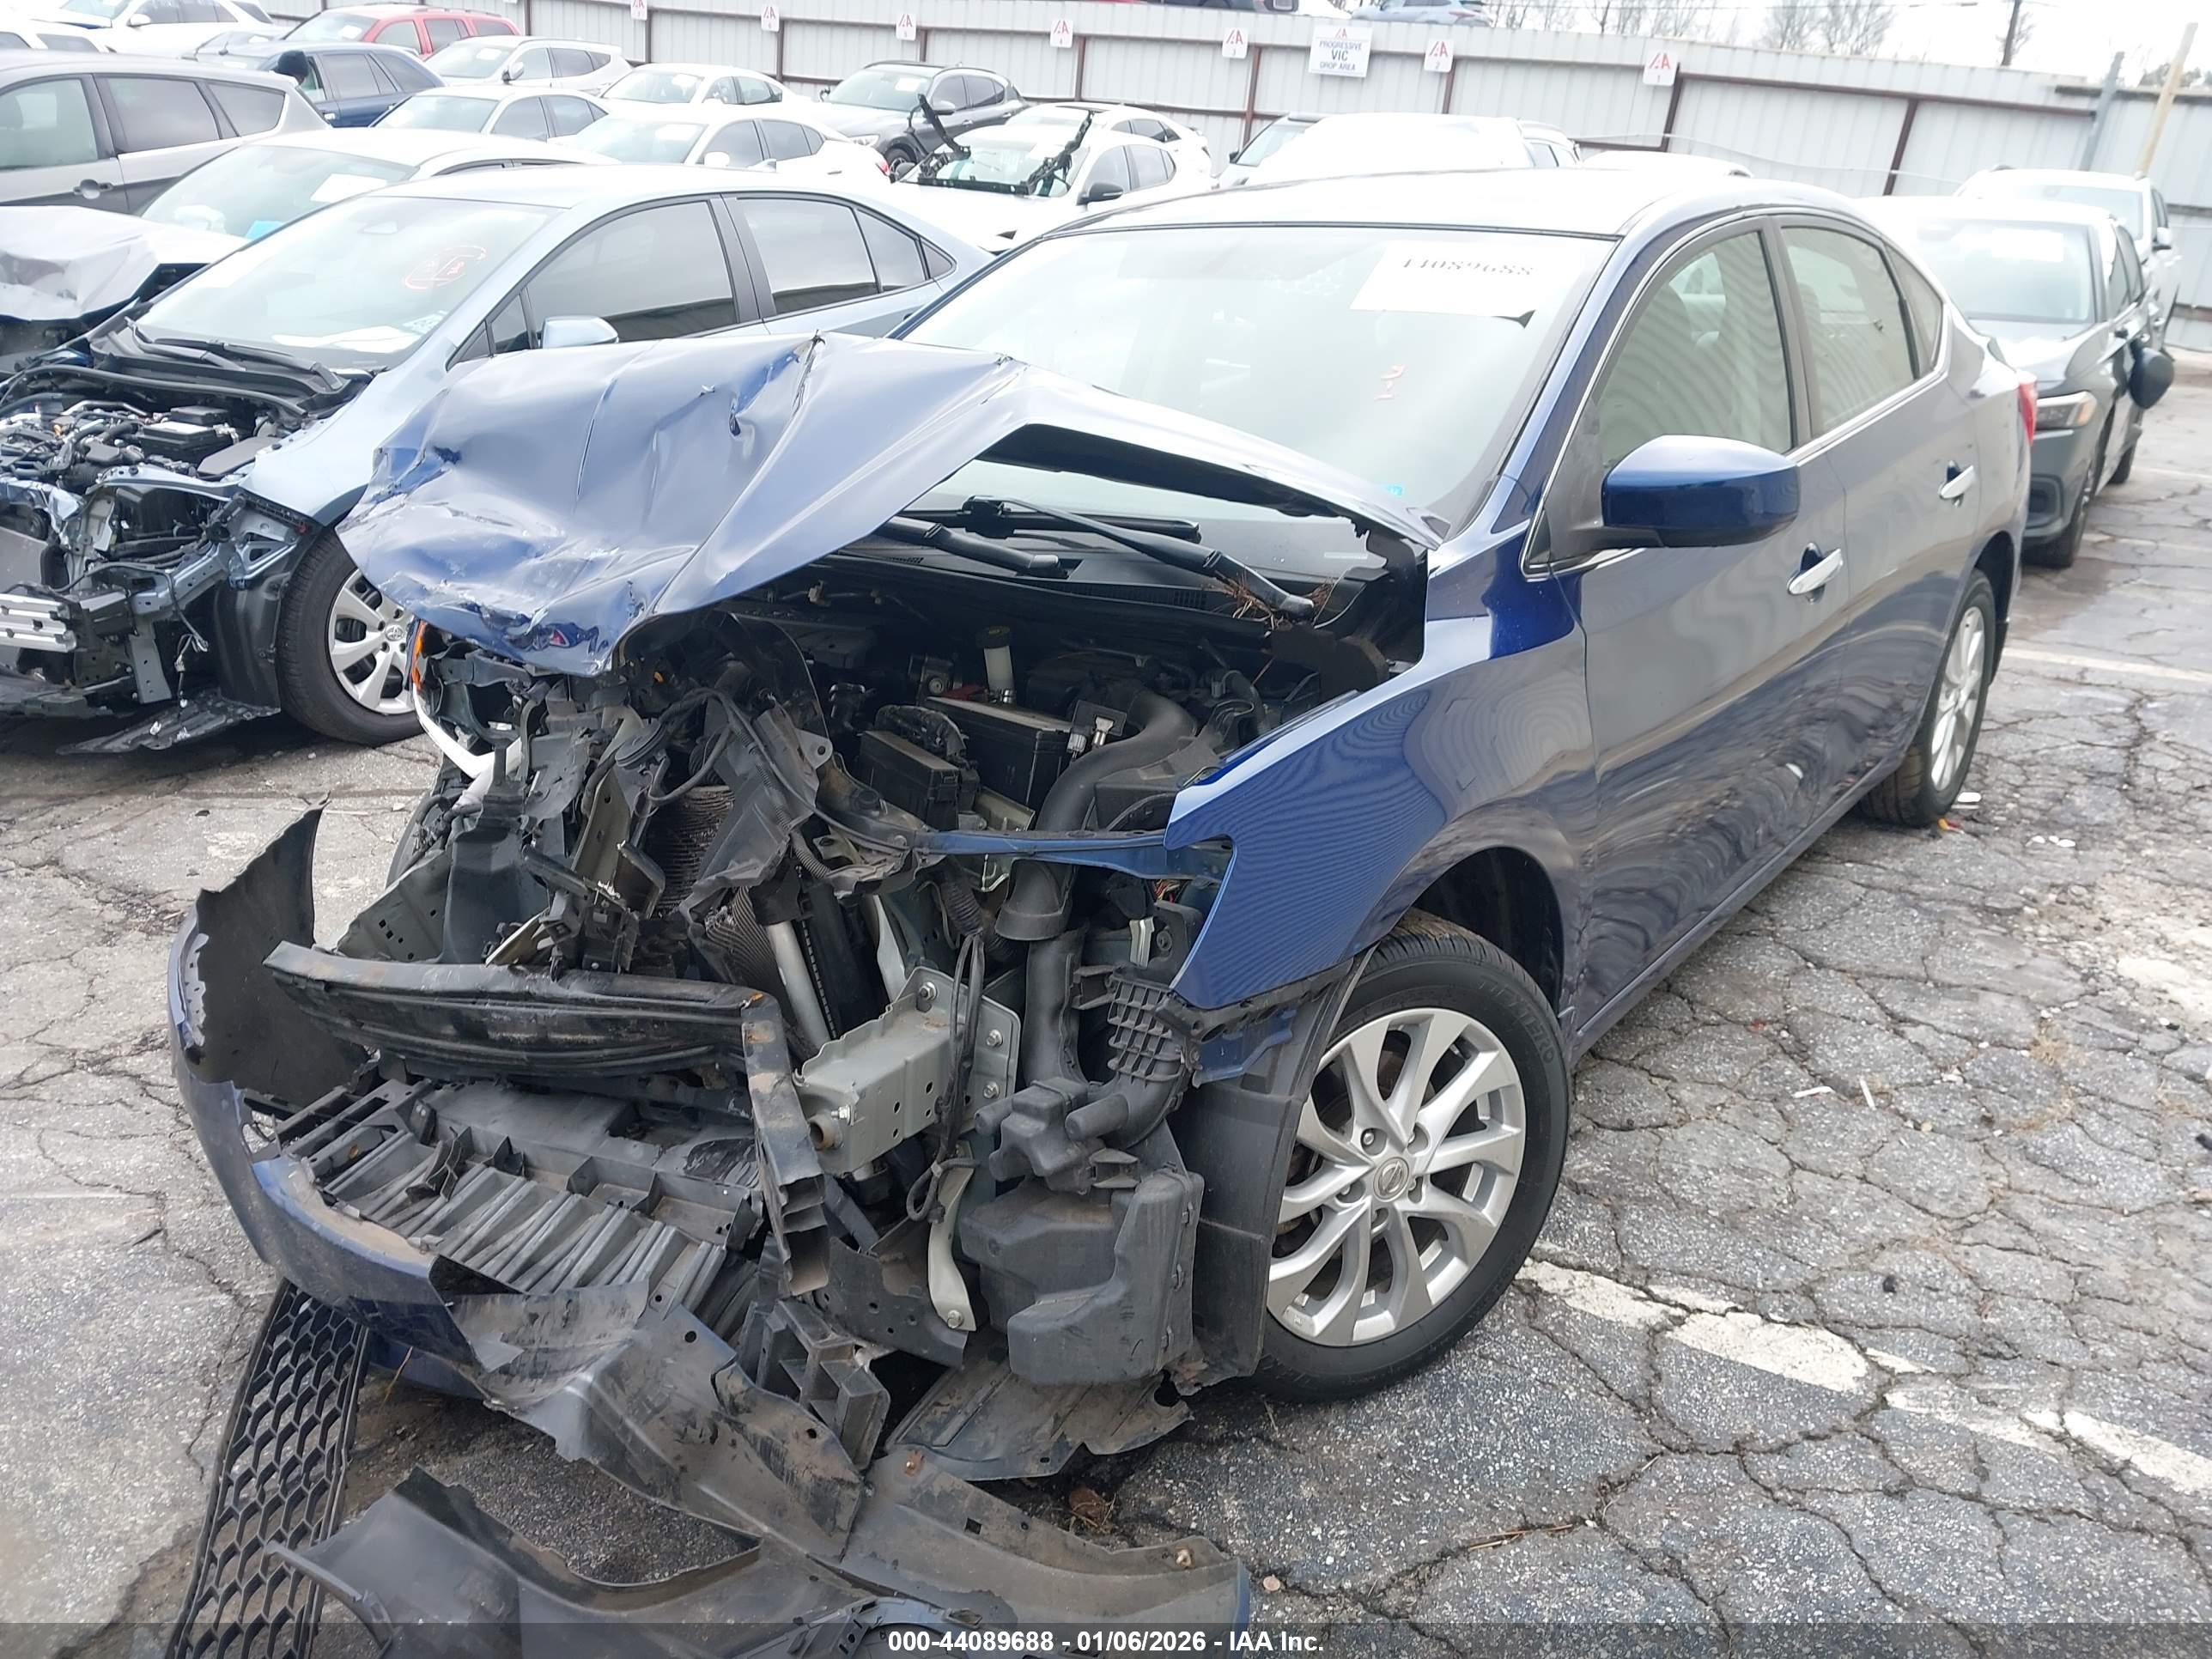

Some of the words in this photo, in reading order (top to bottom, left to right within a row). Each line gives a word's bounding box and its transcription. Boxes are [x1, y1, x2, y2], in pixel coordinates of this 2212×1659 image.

[1319, 40, 1362, 52] PROGRESSIVE
[1332, 49, 1349, 61] VIC
[1319, 61, 1337, 70] DROP
